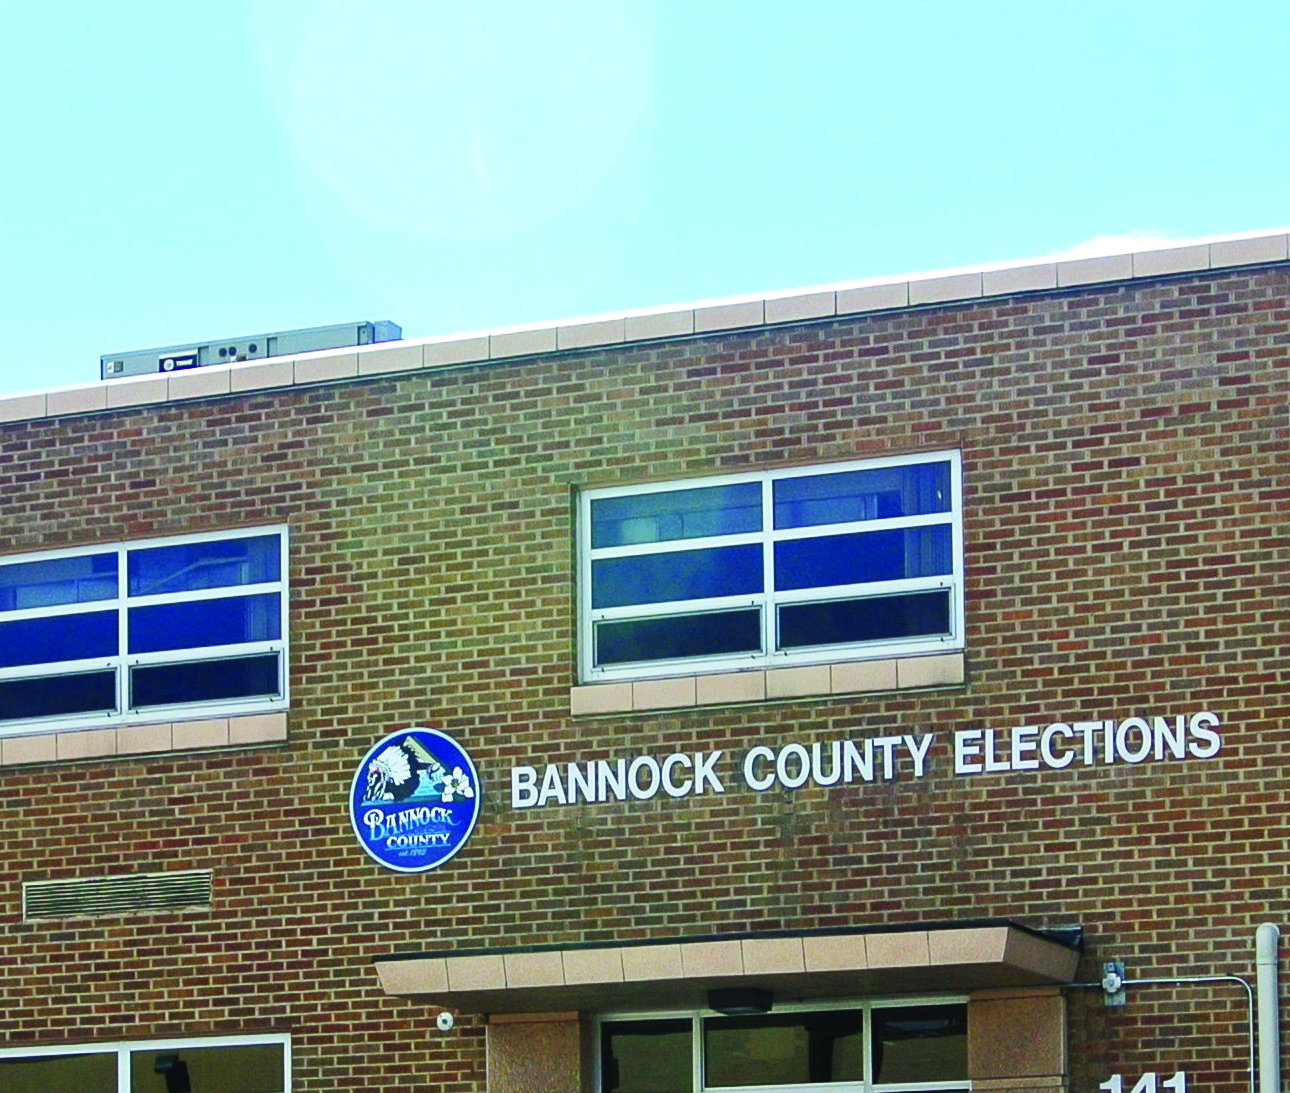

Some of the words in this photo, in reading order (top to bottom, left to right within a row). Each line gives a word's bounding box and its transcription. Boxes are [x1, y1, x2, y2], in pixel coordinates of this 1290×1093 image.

[511, 750, 725, 809] BANNOCK
[743, 732, 934, 792] COUNTY
[954, 711, 1222, 775] ELECTIONS
[363, 806, 461, 841] BANNOCK
[386, 832, 451, 849] COUNTY
